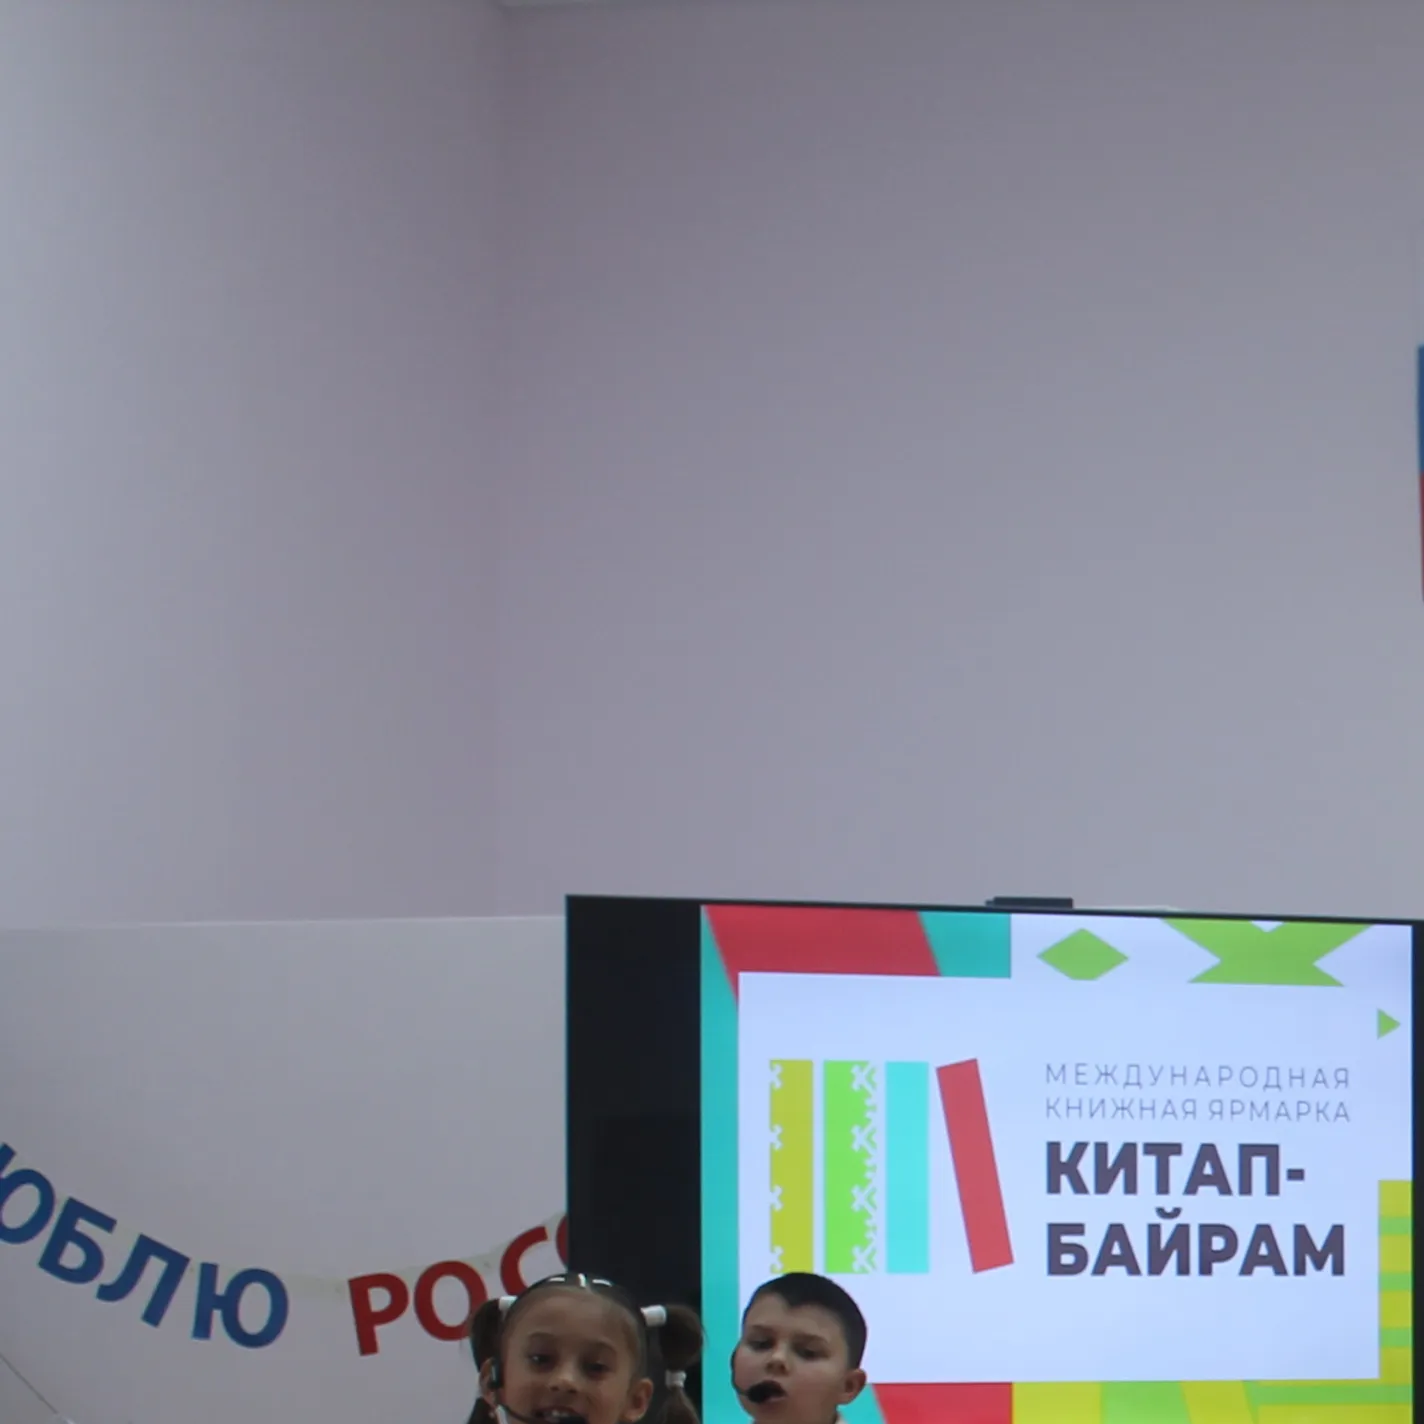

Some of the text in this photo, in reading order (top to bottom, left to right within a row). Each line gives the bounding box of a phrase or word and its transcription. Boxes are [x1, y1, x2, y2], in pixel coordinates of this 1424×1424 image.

[1045, 1063, 1350, 1090] МЕЖДУНАРОДНАЯ
[1045, 1097, 1351, 1123] КНИЖНАЯ ЯРМАРКА
[1045, 1140, 1306, 1197] КИТАП-
[1045, 1206, 1346, 1277] БАЙРАМ
[347, 1213, 569, 1357] РОС
